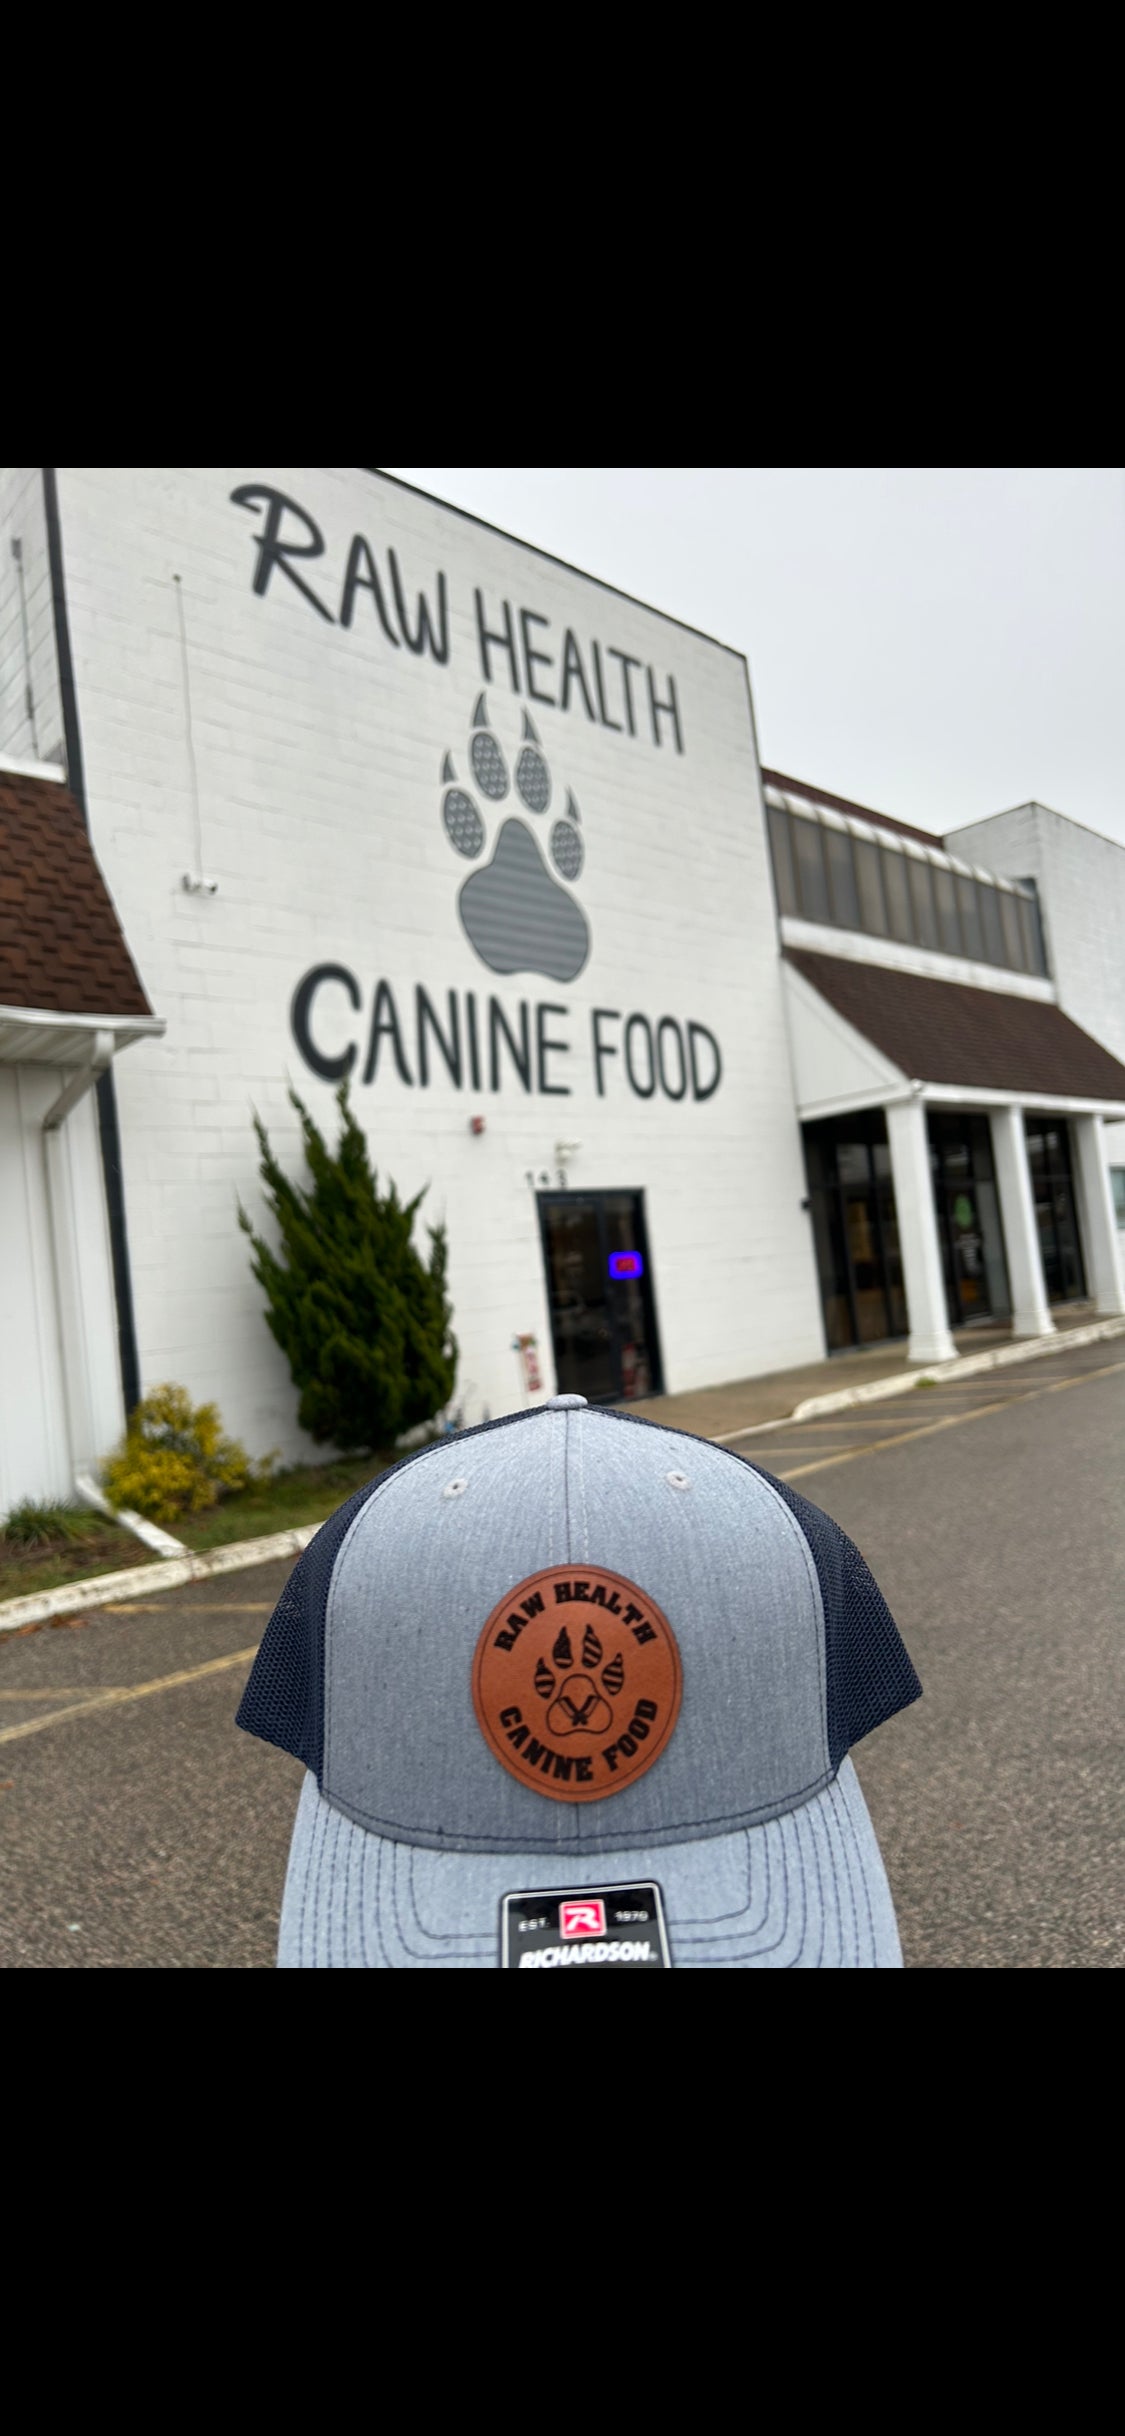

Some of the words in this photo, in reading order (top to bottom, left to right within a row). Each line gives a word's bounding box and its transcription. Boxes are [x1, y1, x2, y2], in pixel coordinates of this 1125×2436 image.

[229, 483, 450, 666] RAW
[474, 586, 686, 756] HEALTH
[290, 962, 572, 1096] CANINE
[592, 1008, 722, 1103] FOOD
[494, 1592, 546, 1652] RAW
[553, 1581, 657, 1646] HEALTH
[500, 1706, 594, 1782] CANINE
[602, 1699, 658, 1772] FOOD
[615, 1911, 649, 1922] 1970
